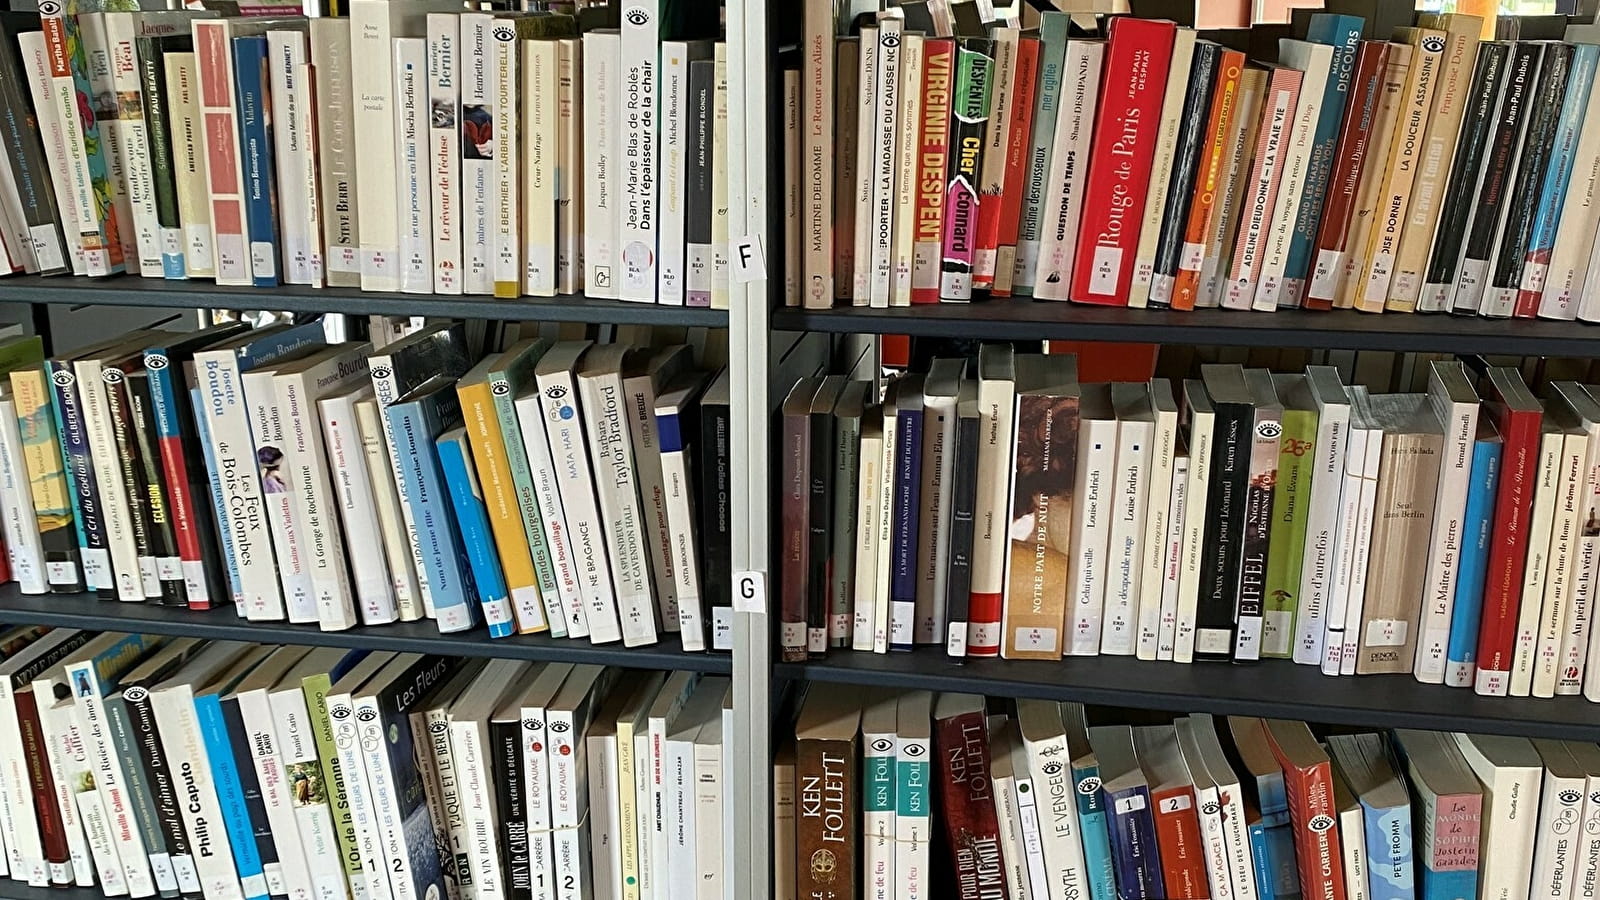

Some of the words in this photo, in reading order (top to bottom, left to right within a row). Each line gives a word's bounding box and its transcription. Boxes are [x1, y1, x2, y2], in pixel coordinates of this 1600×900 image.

[474, 24, 483, 55] Bernier
[813, 35, 822, 64] Alizés
[284, 45, 292, 74] BENNETT
[438, 35, 451, 88] Bernier
[1138, 50, 1149, 90] DESPRAT
[1331, 45, 1342, 73] MAGALI
[1337, 30, 1359, 92] DISCOURS
[147, 60, 158, 90] BEATTY
[285, 76, 293, 89] BRIT
[474, 58, 483, 99] Henriette
[627, 67, 638, 110] Roblès
[642, 60, 651, 94] chair
[884, 66, 894, 106] CAUSSE
[967, 59, 987, 118] DESPENTES
[1128, 49, 1141, 99] JEAN-PAUL
[1414, 56, 1433, 107] ASSASSINE
[150, 92, 160, 114] PAUL
[245, 91, 255, 125] Malavita
[642, 97, 651, 108] la
[813, 88, 821, 122] Retour
[924, 53, 949, 146] VIRGINIE
[500, 112, 508, 131] AUX
[628, 113, 638, 127] de
[641, 111, 651, 126] de
[884, 110, 892, 123] DU
[1273, 108, 1284, 121] VIE
[628, 130, 638, 157] Blas
[813, 125, 821, 136] Le
[1112, 108, 1139, 156] Paris
[1267, 125, 1281, 151] VRAIE
[1403, 111, 1422, 155] DOUCEUR
[249, 138, 260, 177] Benacquista
[438, 136, 448, 174] l'écluse
[500, 133, 508, 172] L'ARBRE
[640, 129, 653, 194] l'épaisseur
[883, 126, 892, 175] MADASSE
[960, 137, 980, 175] Cher
[1064, 151, 1075, 179] TEMPS
[1264, 154, 1274, 166] LA
[813, 146, 821, 200] DELOMME
[1114, 162, 1131, 179] de
[1399, 160, 1409, 171] LA
[252, 179, 261, 200] Tonino
[336, 181, 349, 212] BERRY
[439, 176, 448, 190] de
[627, 160, 638, 229] Jean-Marie
[883, 177, 890, 189] LA
[1062, 183, 1071, 194] DE
[439, 192, 449, 226] rêveur
[500, 181, 509, 225] BERTHIER
[641, 197, 651, 230] Dans
[1097, 185, 1127, 245] Rouge
[1251, 179, 1269, 230] DIEUDONNÉ
[339, 215, 351, 244] STEVE
[813, 203, 822, 251] MARTINE
[1056, 198, 1071, 241] QUESTION
[440, 229, 450, 241] Le
[1244, 232, 1258, 267] ADELINE
[739, 244, 751, 268] F
[206, 361, 223, 415] Boudou
[221, 368, 235, 405] Josette
[601, 386, 620, 443] Bradford
[403, 416, 418, 454] Bourdin
[597, 420, 610, 458] Barbara
[1227, 419, 1237, 443] Essex
[219, 442, 227, 453] de
[1224, 447, 1235, 471] Karen
[414, 457, 429, 503] Françoise
[612, 447, 630, 488] Taylor
[1287, 465, 1298, 491] Evans
[1568, 455, 1579, 481] Ferrari
[302, 466, 317, 514] Rochebrune
[1088, 470, 1100, 500] Erdrich
[1176, 483, 1184, 499] vides
[1219, 481, 1232, 518] Léonard
[1564, 484, 1576, 512] Jérôme
[222, 458, 251, 565] Bois-Colombes
[241, 475, 250, 492] Les
[246, 496, 259, 530] Feux
[521, 486, 541, 546] bourgeoises
[1038, 494, 1049, 523] NUIT
[1087, 502, 1098, 528] Louise
[1284, 494, 1295, 522] Diana
[311, 516, 319, 527] de
[1037, 526, 1046, 541] DE
[1219, 521, 1230, 542] pour
[1444, 519, 1458, 550] pierres
[311, 529, 326, 557] Grange
[318, 559, 326, 568] La
[536, 550, 552, 589] grandes
[1035, 544, 1045, 572] PART
[1217, 545, 1226, 573] sœurs
[1441, 552, 1453, 568] des
[741, 578, 754, 598] G
[1033, 576, 1043, 614] NOTRE
[1213, 575, 1224, 599] Deux
[1241, 553, 1264, 614] EIFFEL
[1438, 571, 1450, 600] Maître
[1435, 603, 1445, 615] Le
[396, 693, 415, 712] Les
[417, 659, 446, 691] Fleurs
[84, 699, 97, 721] âmes
[287, 714, 299, 733] Cario
[91, 724, 102, 737] des
[255, 732, 266, 755] DANIEL
[263, 734, 273, 754] CARIO
[97, 741, 112, 771] Rivière
[292, 734, 304, 758] Daniel
[505, 737, 514, 767] DÉLICATE
[948, 747, 967, 783] KEN
[961, 724, 989, 801] FOLLETT
[106, 774, 115, 785] La
[180, 762, 200, 814] Caputo
[330, 758, 349, 808] Séranne
[508, 779, 518, 801] VÉRITÉ
[531, 759, 539, 797] ROYAUME
[110, 789, 124, 812] Calmel
[511, 803, 519, 815] UNE
[533, 800, 540, 808] LE
[803, 777, 821, 817] KEN
[823, 752, 844, 842] FOLLETT
[1125, 800, 1132, 810] 1
[1170, 799, 1178, 810] 2
[116, 814, 131, 841] Mireille
[342, 812, 353, 824] la
[1230, 803, 1241, 846] CAUCHEMARS
[196, 817, 212, 858] Philip
[345, 827, 357, 842] de
[506, 822, 526, 853] CARRÉ
[1392, 820, 1401, 854] FROMM
[351, 847, 362, 871] L'Or
[511, 855, 526, 863] le
[958, 848, 973, 872] RIEN
[1239, 865, 1247, 882] DIEU
[1393, 856, 1401, 877] PETE
[513, 865, 530, 889] JOHN
[537, 874, 543, 886] 1
[565, 876, 574, 889] 2
[961, 875, 977, 899] POUR
[1242, 886, 1248, 894] LE
